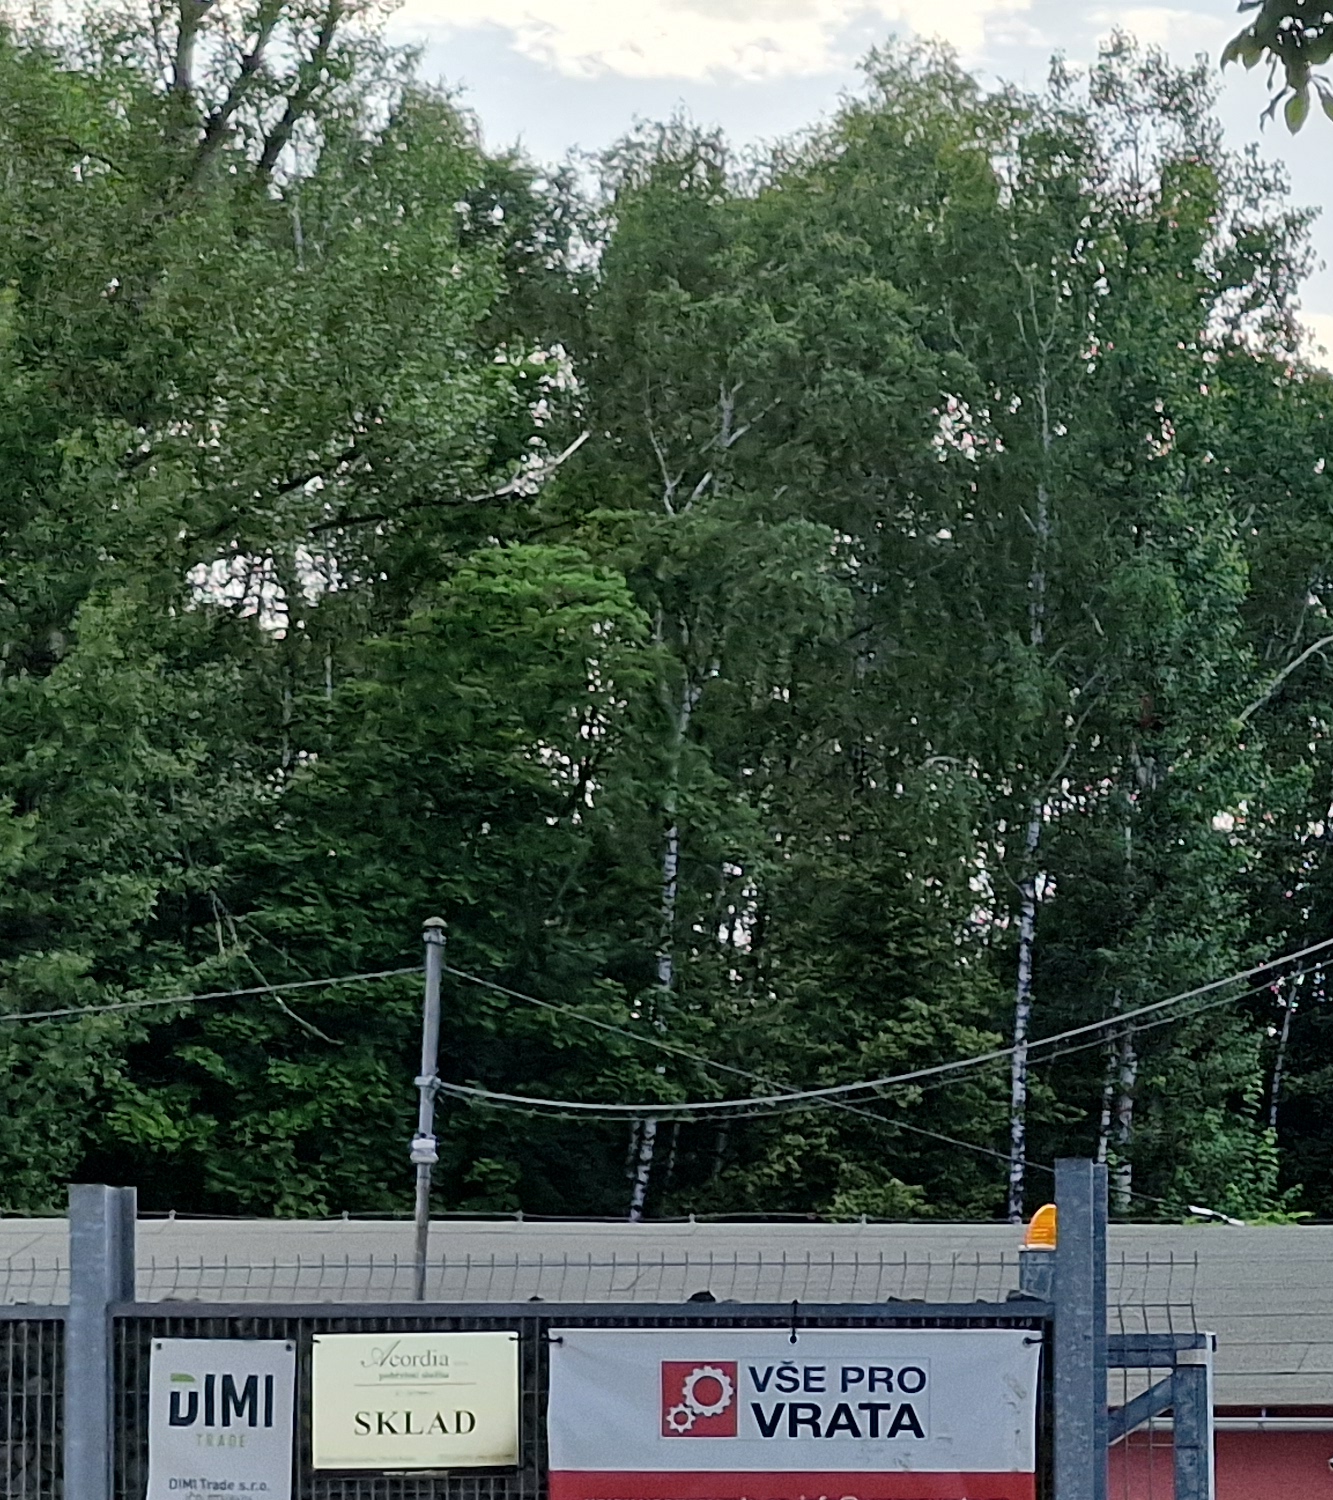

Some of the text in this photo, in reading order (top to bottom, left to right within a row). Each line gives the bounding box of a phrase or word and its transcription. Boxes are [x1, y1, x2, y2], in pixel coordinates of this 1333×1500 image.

[360, 1340, 449, 1368] Acordia
[748, 1361, 926, 1393] VŠE PRO
[169, 1373, 274, 1427] DIMI
[353, 1410, 477, 1436] SKLAD
[750, 1403, 925, 1438] VRATA
[196, 1434, 246, 1448] TRADE
[168, 1478, 271, 1492] DIMI Trade s.r.o.
